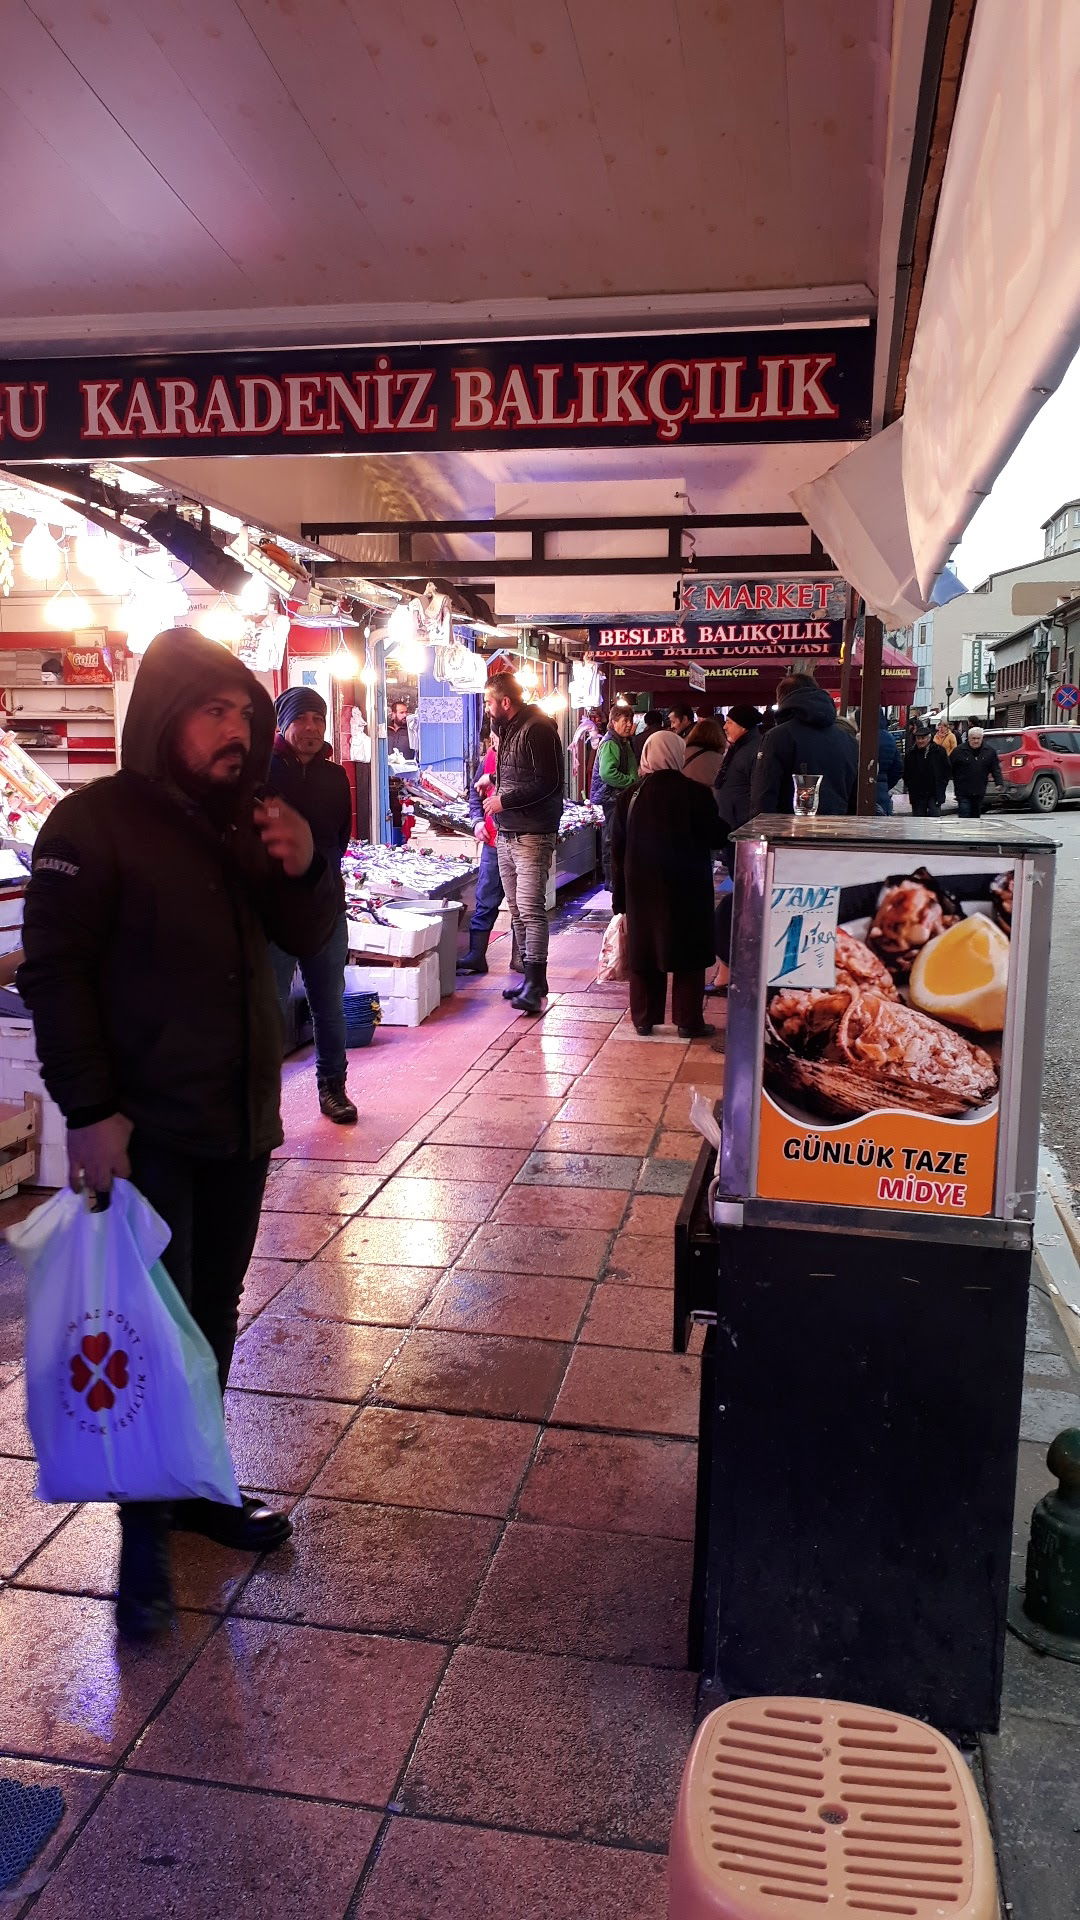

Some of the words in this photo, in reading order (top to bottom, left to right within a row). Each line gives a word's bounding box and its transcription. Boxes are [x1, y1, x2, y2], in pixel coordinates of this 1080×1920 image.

[82, 358, 437, 439] KARADENİZ
[452, 355, 836, 438] BALIKÇILIK
[705, 583, 834, 610] MARKET
[599, 627, 686, 647] BESLER
[698, 622, 832, 645] BALIKÇILIK
[770, 886, 838, 913] TANE
[768, 915, 806, 983] 1
[783, 1133, 895, 1170] GÜNLÜK
[901, 1147, 968, 1176] TAZE
[878, 1174, 967, 1207] MİDYE
